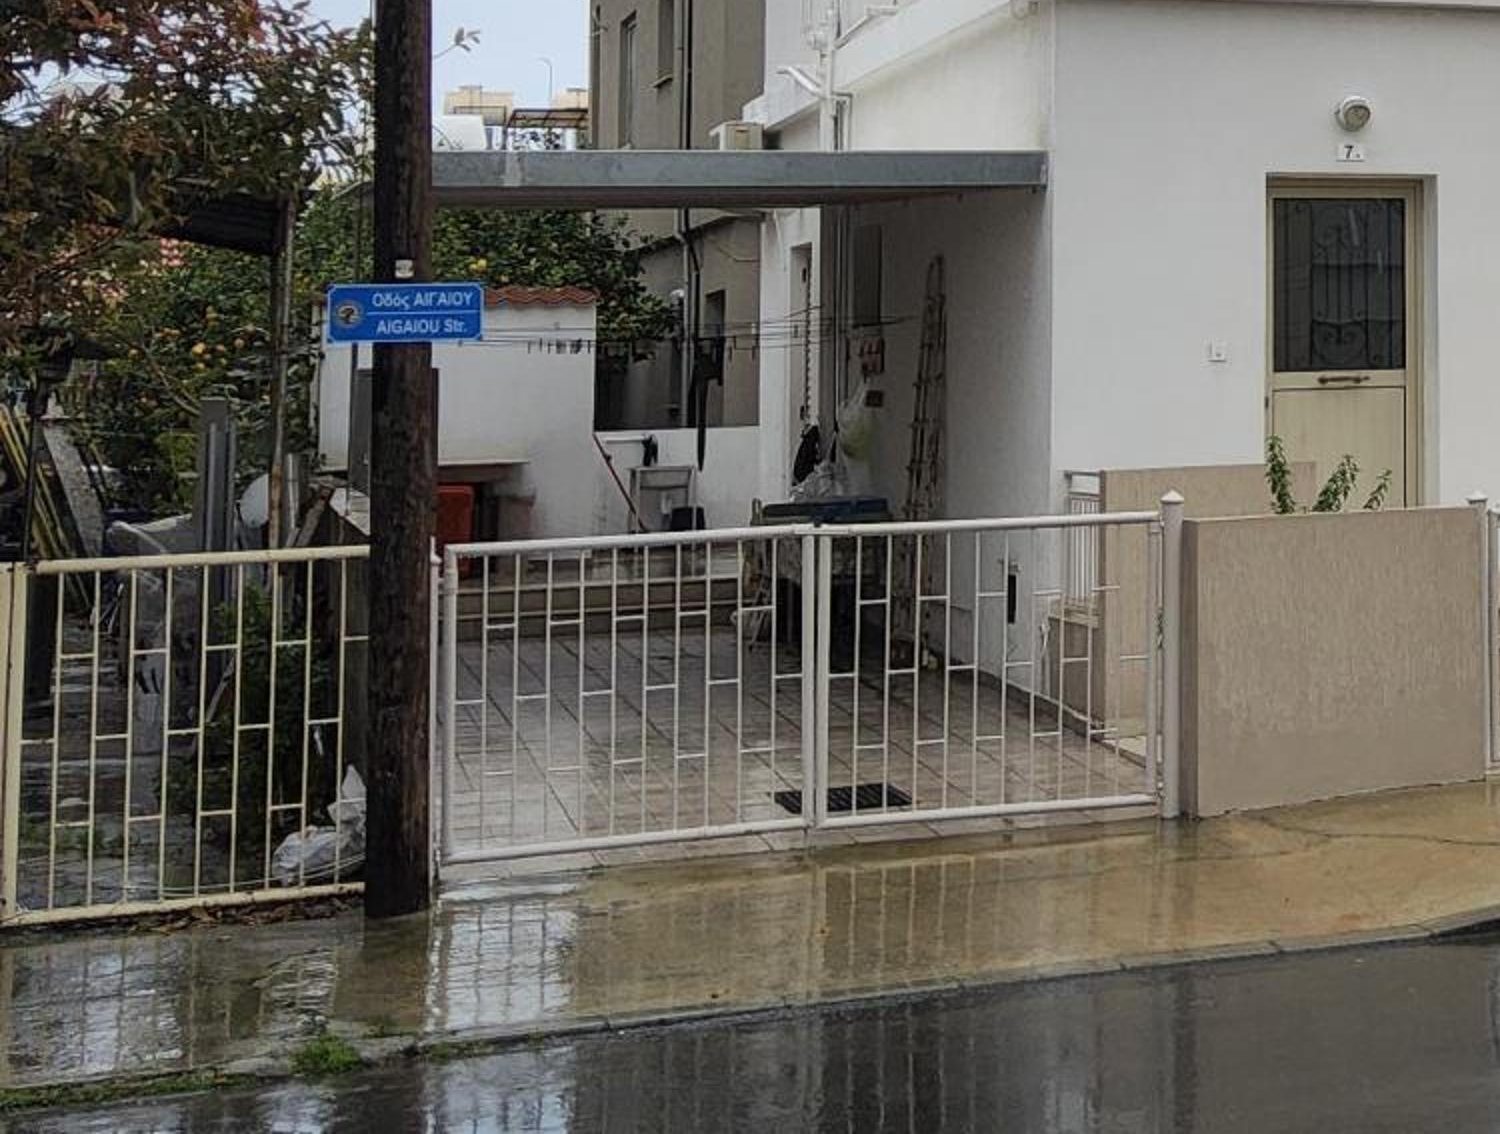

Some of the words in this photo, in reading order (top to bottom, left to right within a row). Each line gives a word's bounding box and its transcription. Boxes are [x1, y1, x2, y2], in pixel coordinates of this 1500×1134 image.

[414, 292, 473, 307] ΑΙΓΑΙΟΥ
[376, 320, 439, 334] AIGAIOU
[444, 320, 467, 333] Str.
